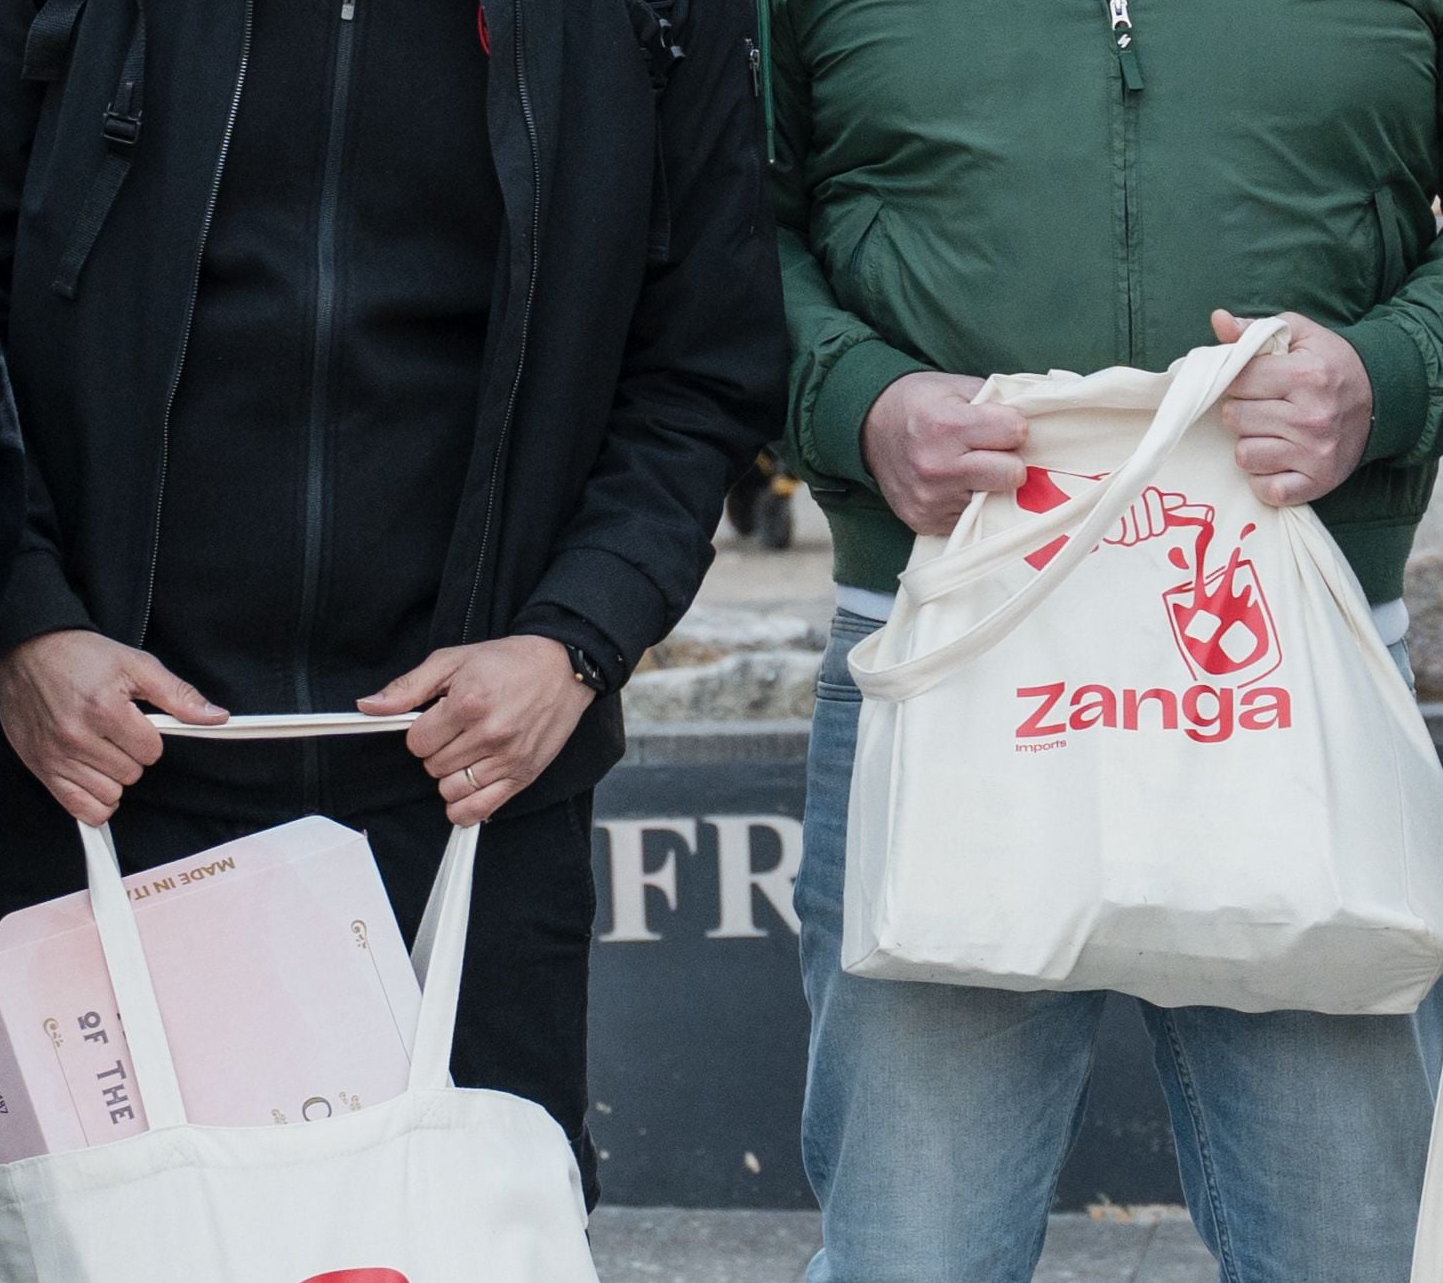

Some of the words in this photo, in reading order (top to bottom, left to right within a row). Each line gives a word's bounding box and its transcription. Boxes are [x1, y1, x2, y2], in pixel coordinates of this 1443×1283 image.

[1015, 681, 1292, 743] Zanga
[152, 879, 176, 895] IN
[181, 856, 236, 885] MADE
[594, 813, 804, 943] FR
[96, 1059, 135, 1125] THE
